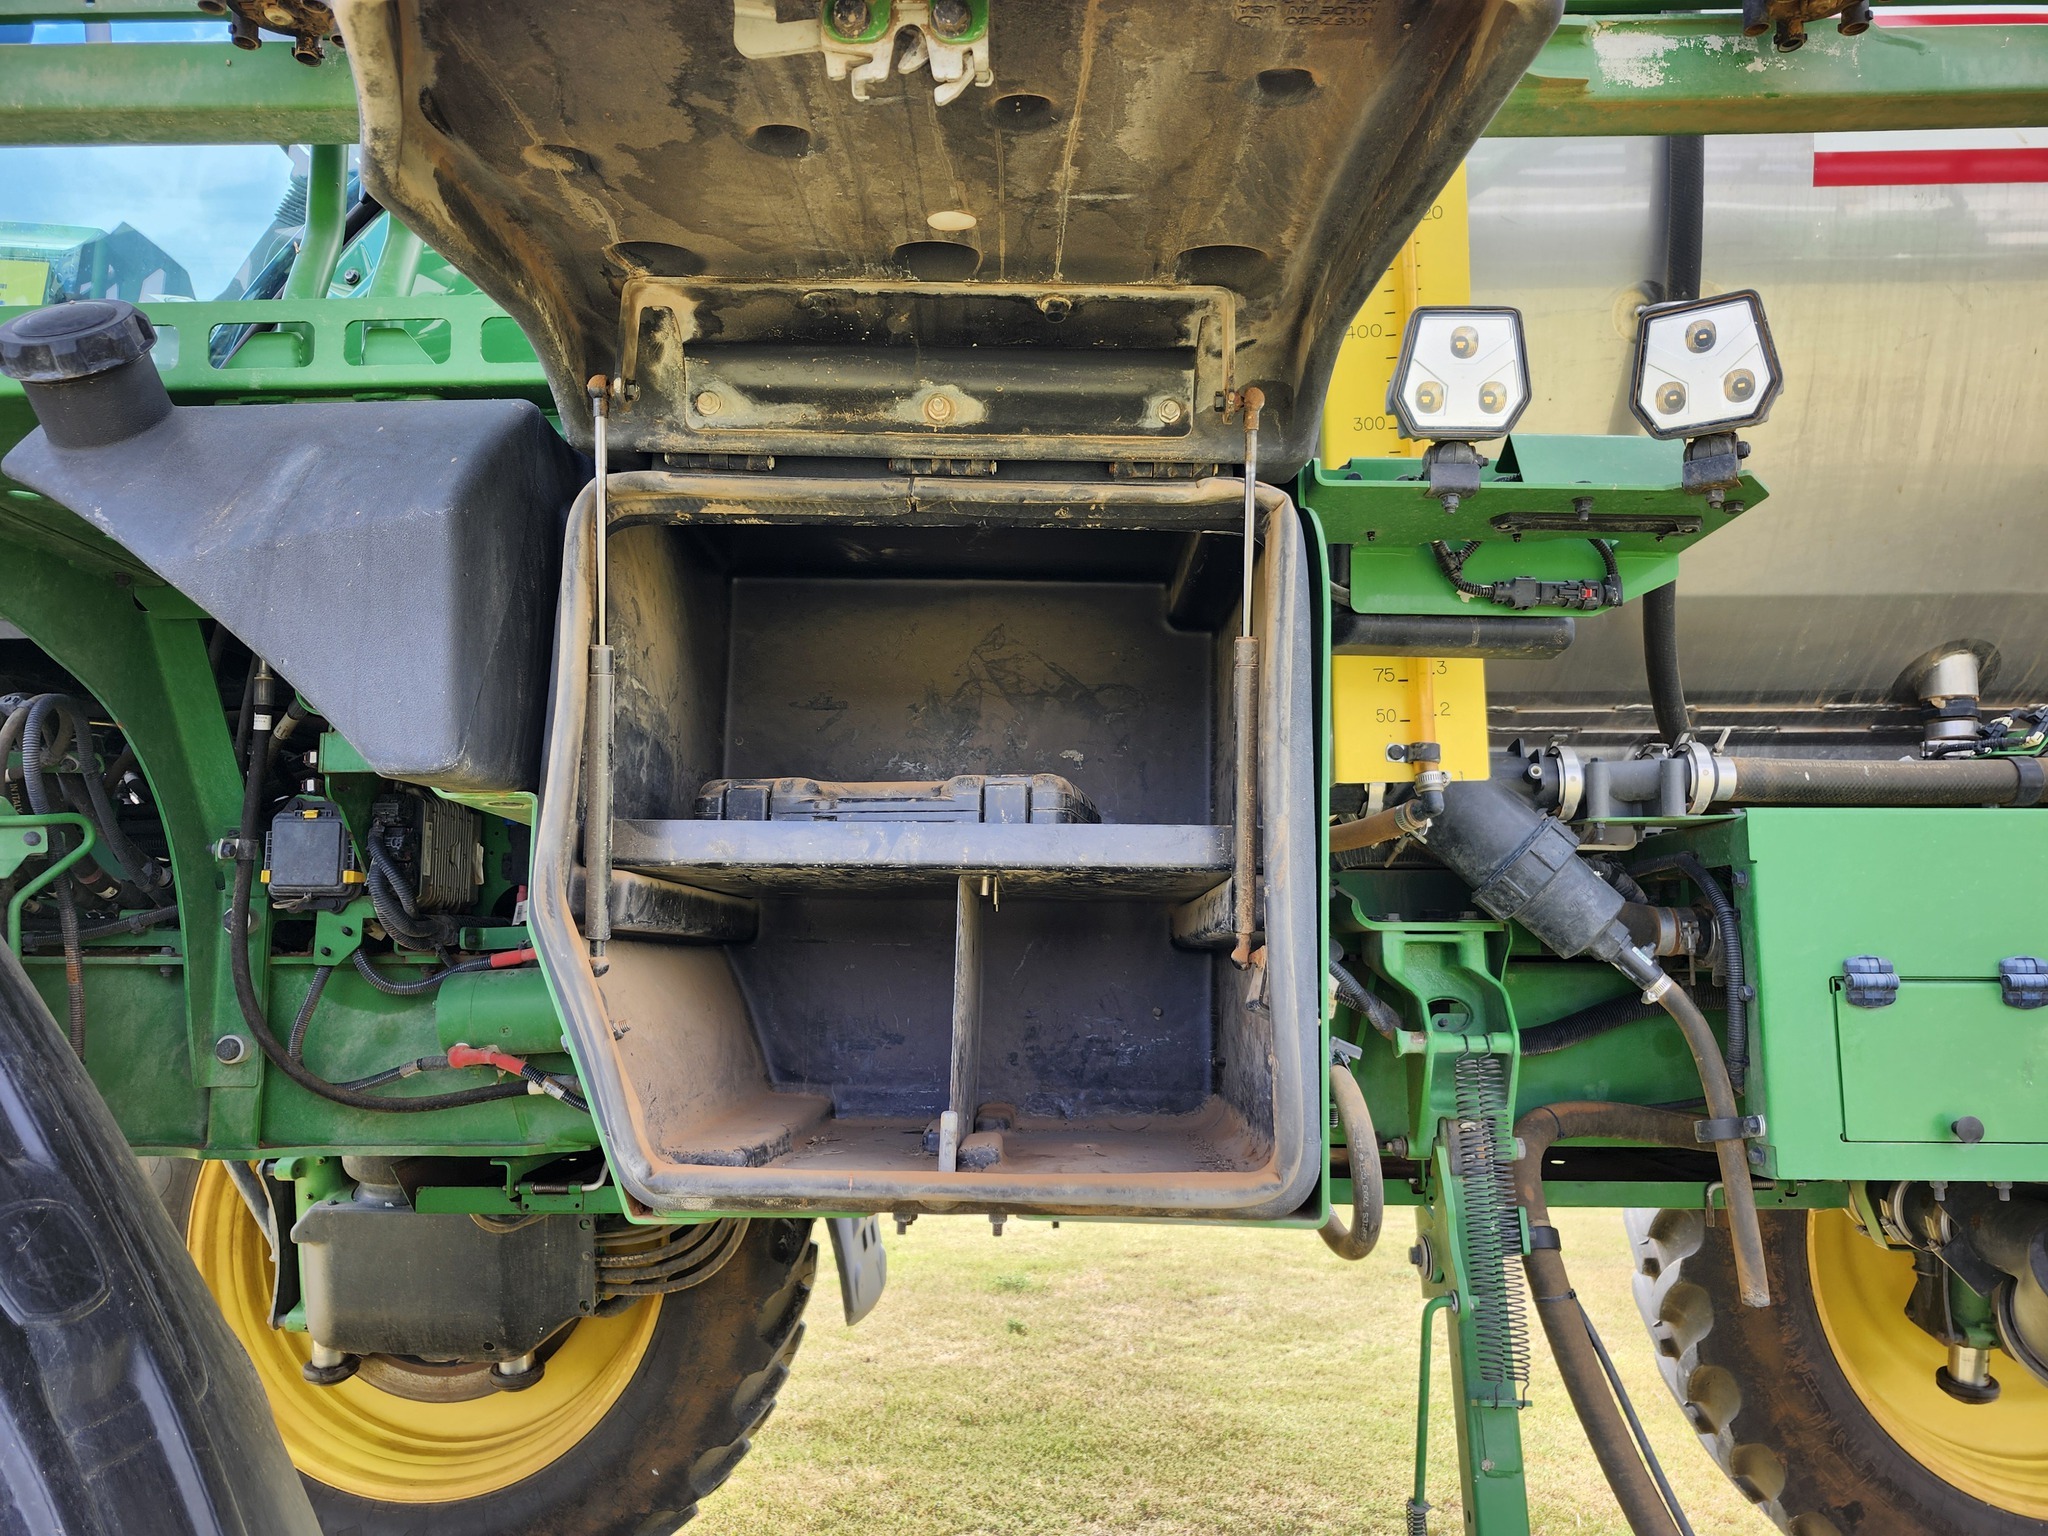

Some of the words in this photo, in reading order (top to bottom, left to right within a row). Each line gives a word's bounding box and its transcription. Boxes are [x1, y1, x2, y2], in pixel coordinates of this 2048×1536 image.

[1237, 5, 1276, 15] USA
[1288, 6, 1309, 15] IN
[1346, 323, 1382, 339] 400
[1353, 416, 1385, 431] 300
[1373, 668, 1395, 682] 75
[1376, 708, 1397, 723] 50
